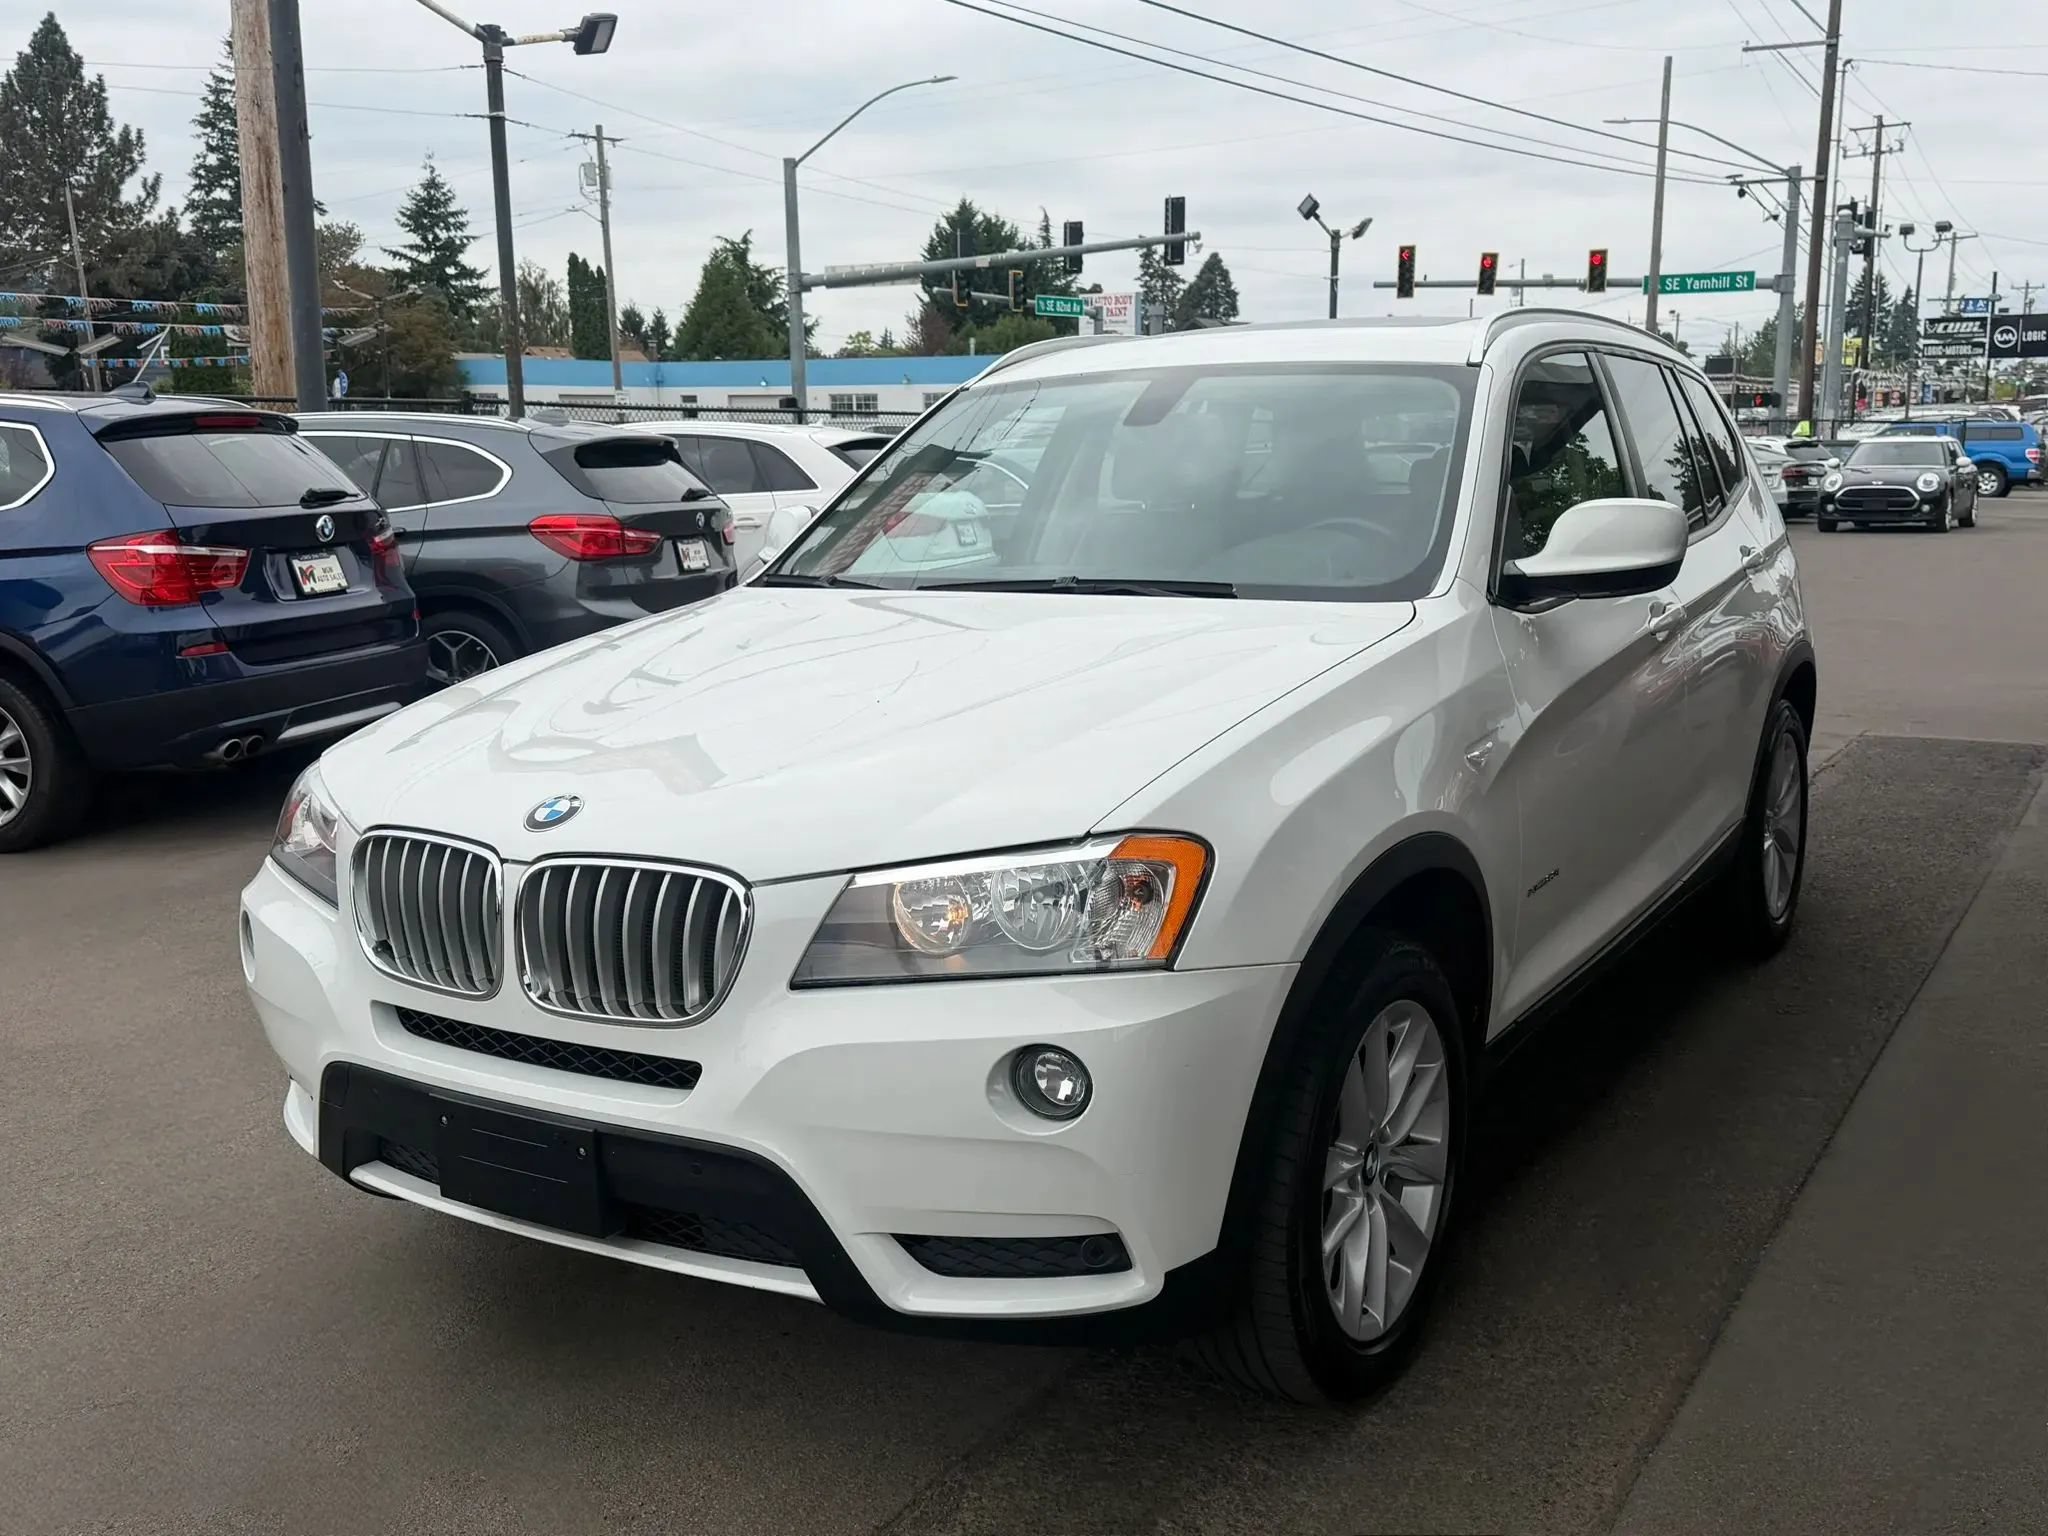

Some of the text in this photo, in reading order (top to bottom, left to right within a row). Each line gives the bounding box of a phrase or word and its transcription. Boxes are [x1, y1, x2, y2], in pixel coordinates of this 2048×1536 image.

[1665, 275, 1749, 290] SE Yamhill St
[1046, 300, 1055, 312] SE
[1056, 300, 1071, 312] 82nd
[1114, 295, 1133, 305] BODY
[2022, 330, 2047, 342] LOGIC
